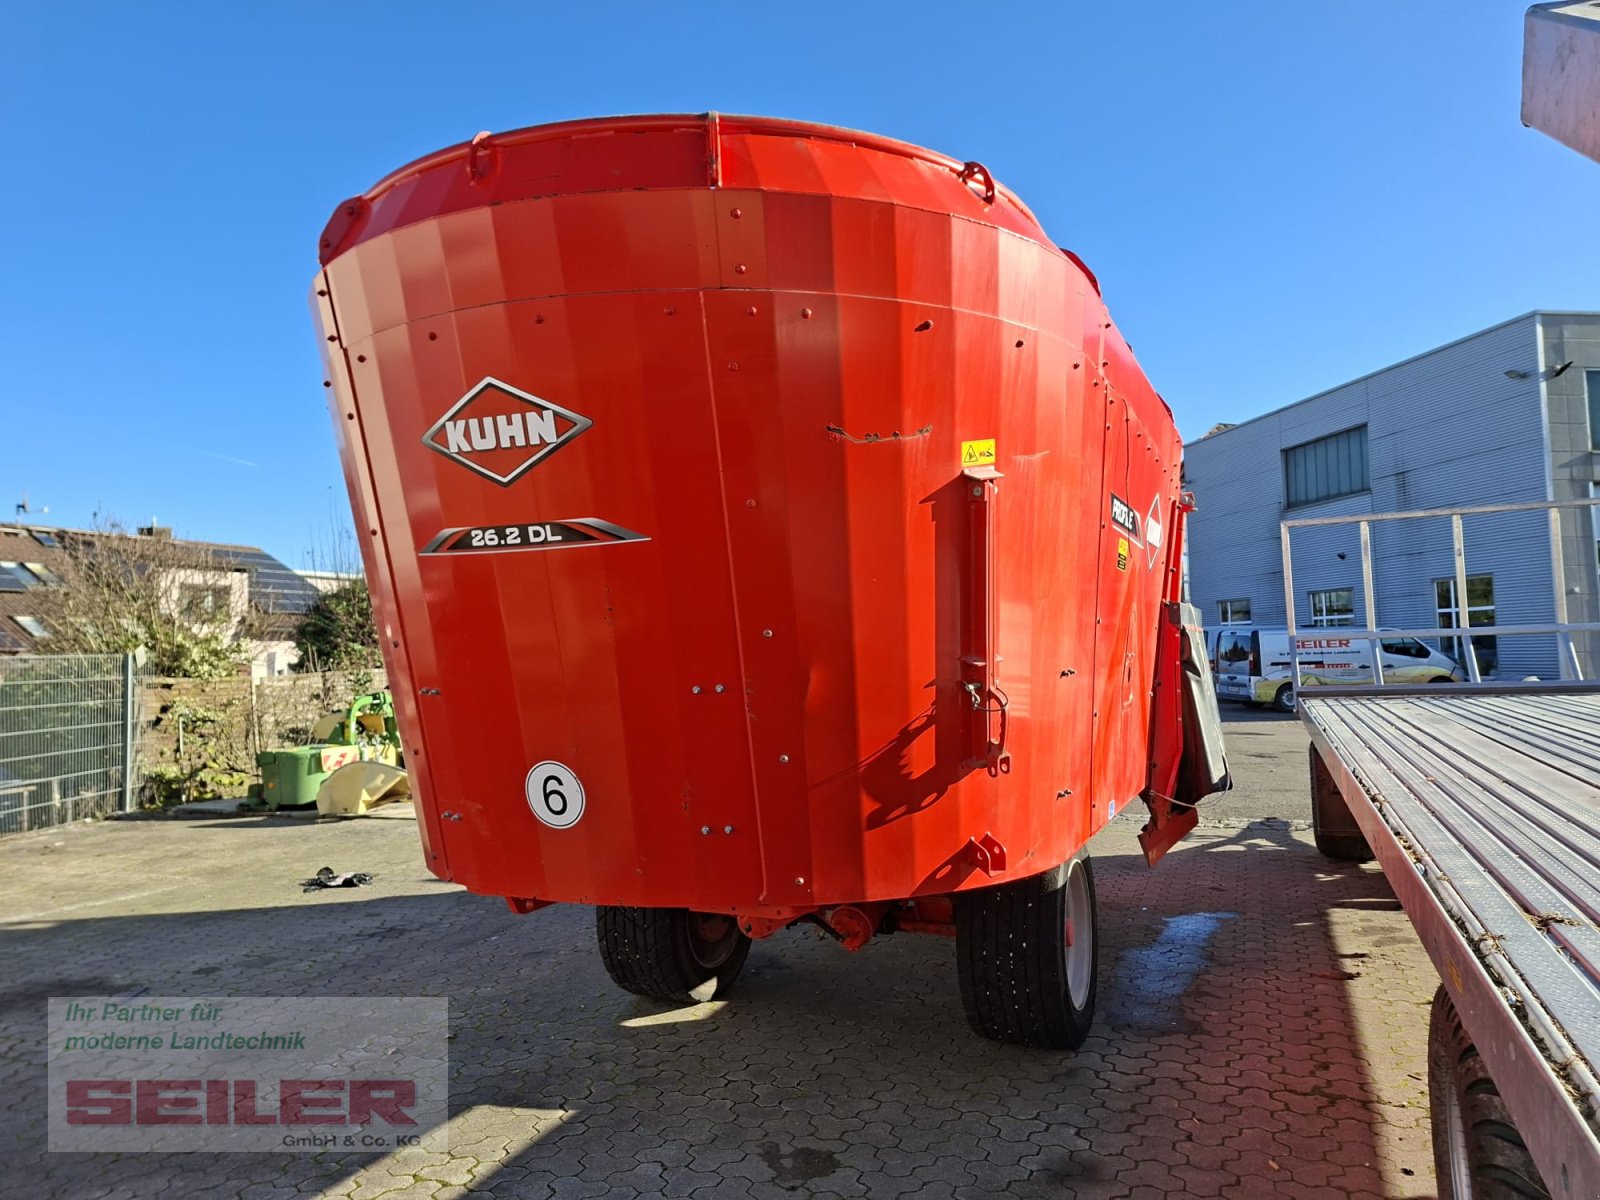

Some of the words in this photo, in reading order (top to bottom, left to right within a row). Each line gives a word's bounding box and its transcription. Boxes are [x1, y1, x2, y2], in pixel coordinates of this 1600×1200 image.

[445, 409, 558, 453] KUHN
[471, 527, 521, 546] 26.2
[528, 525, 563, 542] DL
[542, 775, 568, 815] 6
